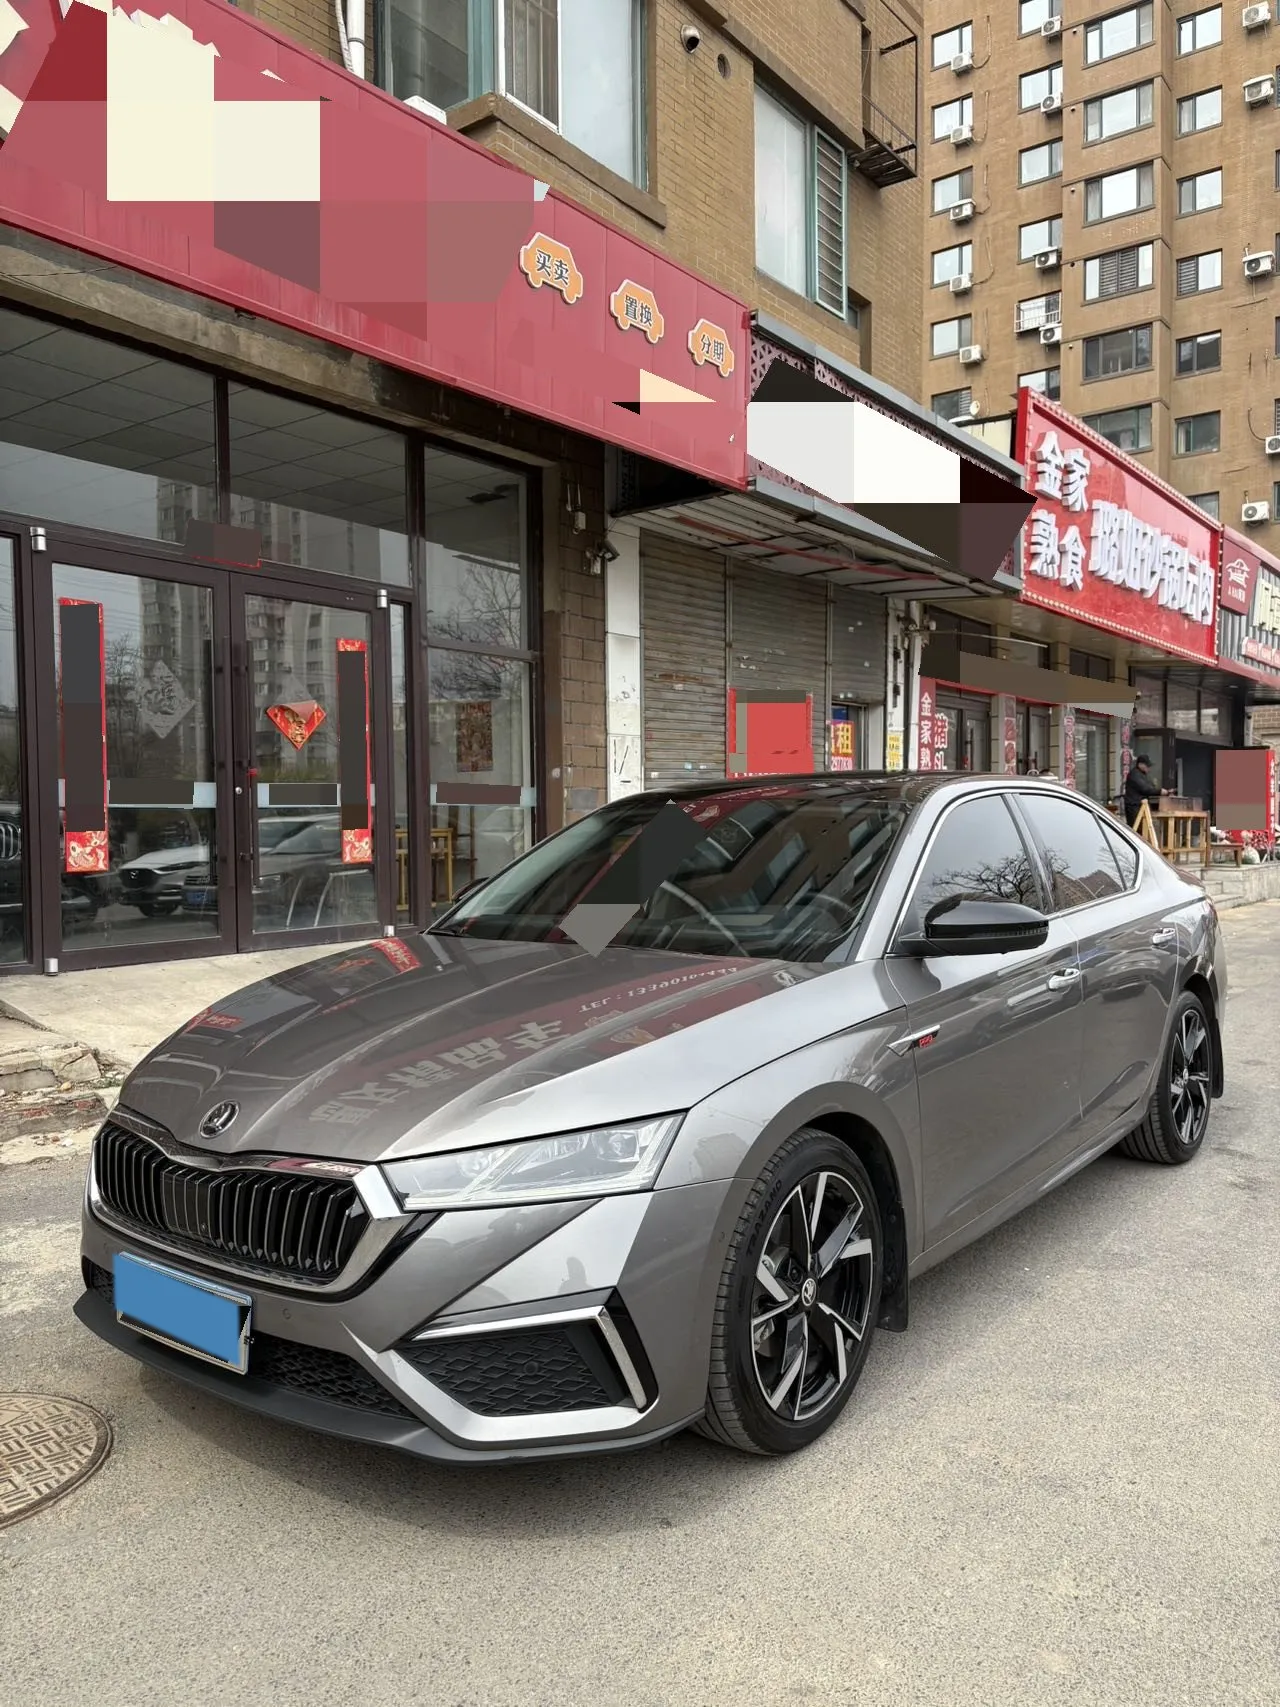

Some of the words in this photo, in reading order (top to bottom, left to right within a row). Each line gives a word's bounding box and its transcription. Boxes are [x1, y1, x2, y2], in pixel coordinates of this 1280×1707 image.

[536, 248, 569, 286] 买卖
[624, 294, 653, 327] 置换
[700, 333, 725, 363] 分期
[1033, 430, 1091, 513] 金家
[1029, 508, 1087, 592] 熟食
